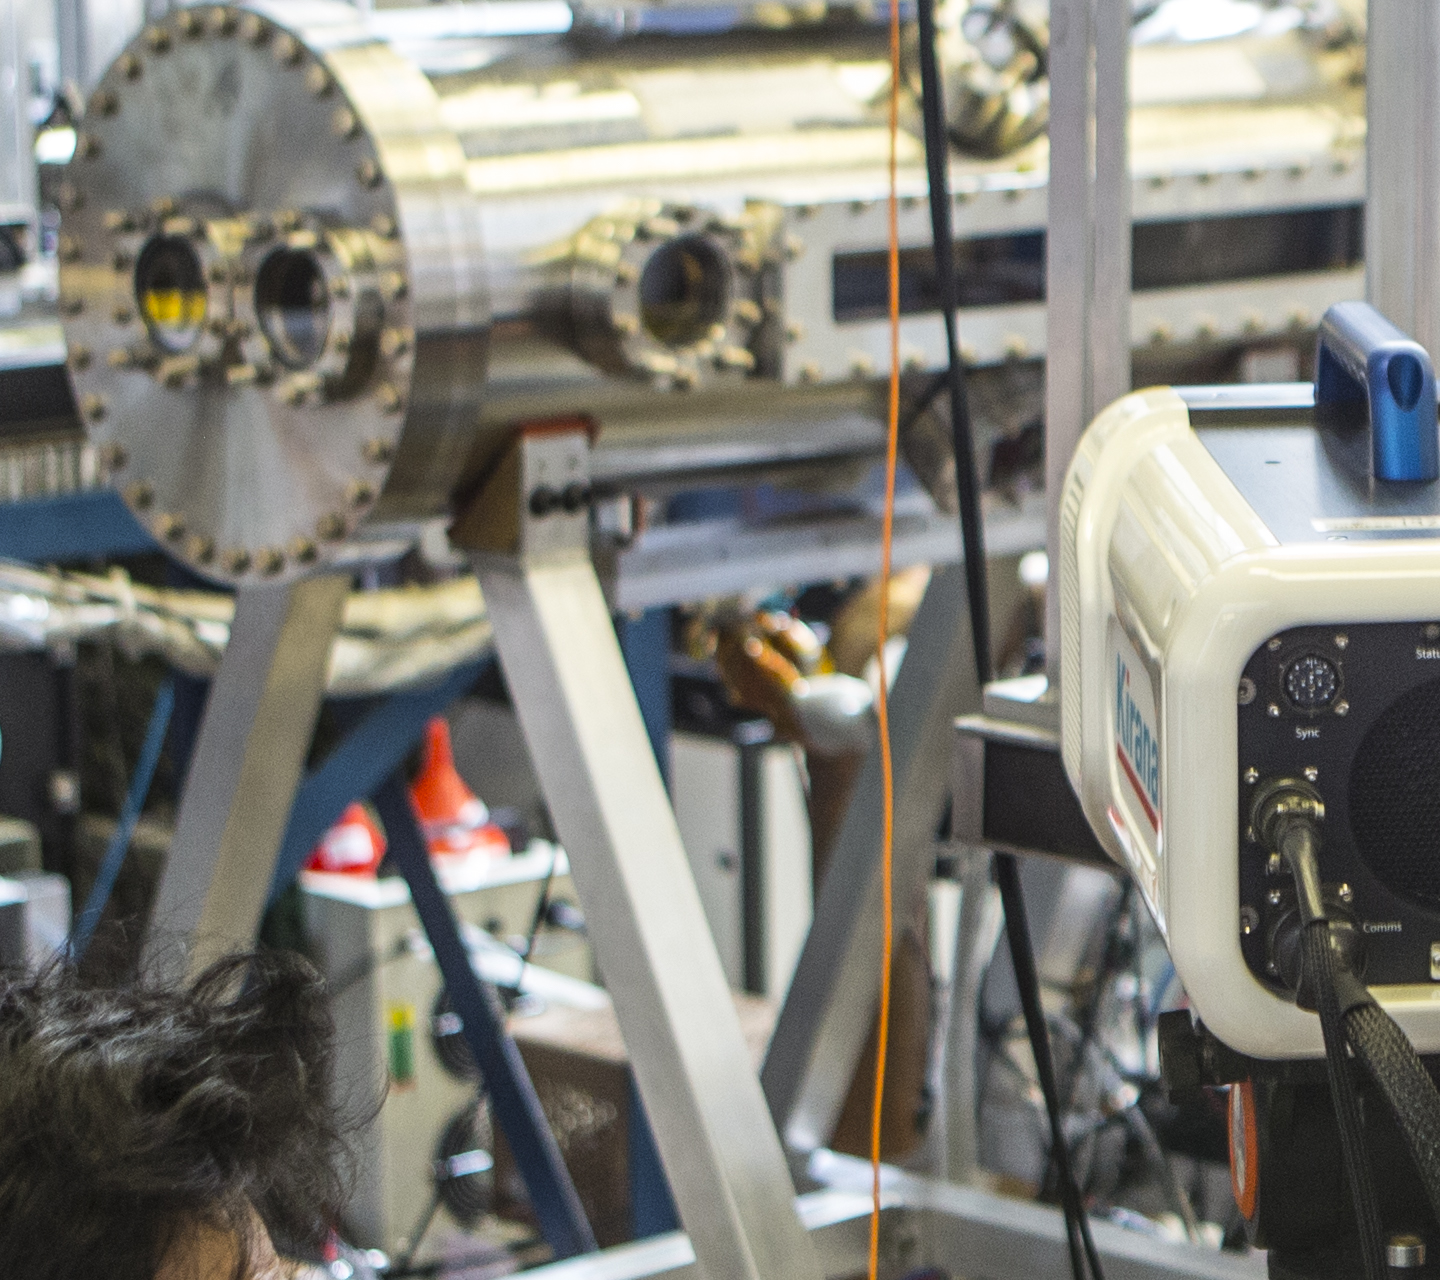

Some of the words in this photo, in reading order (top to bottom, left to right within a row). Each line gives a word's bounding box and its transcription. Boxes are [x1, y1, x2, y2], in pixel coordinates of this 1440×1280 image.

[1116, 651, 1159, 808] Kirana
[1295, 725, 1320, 741] Sync
[1363, 921, 1402, 934] Comms
